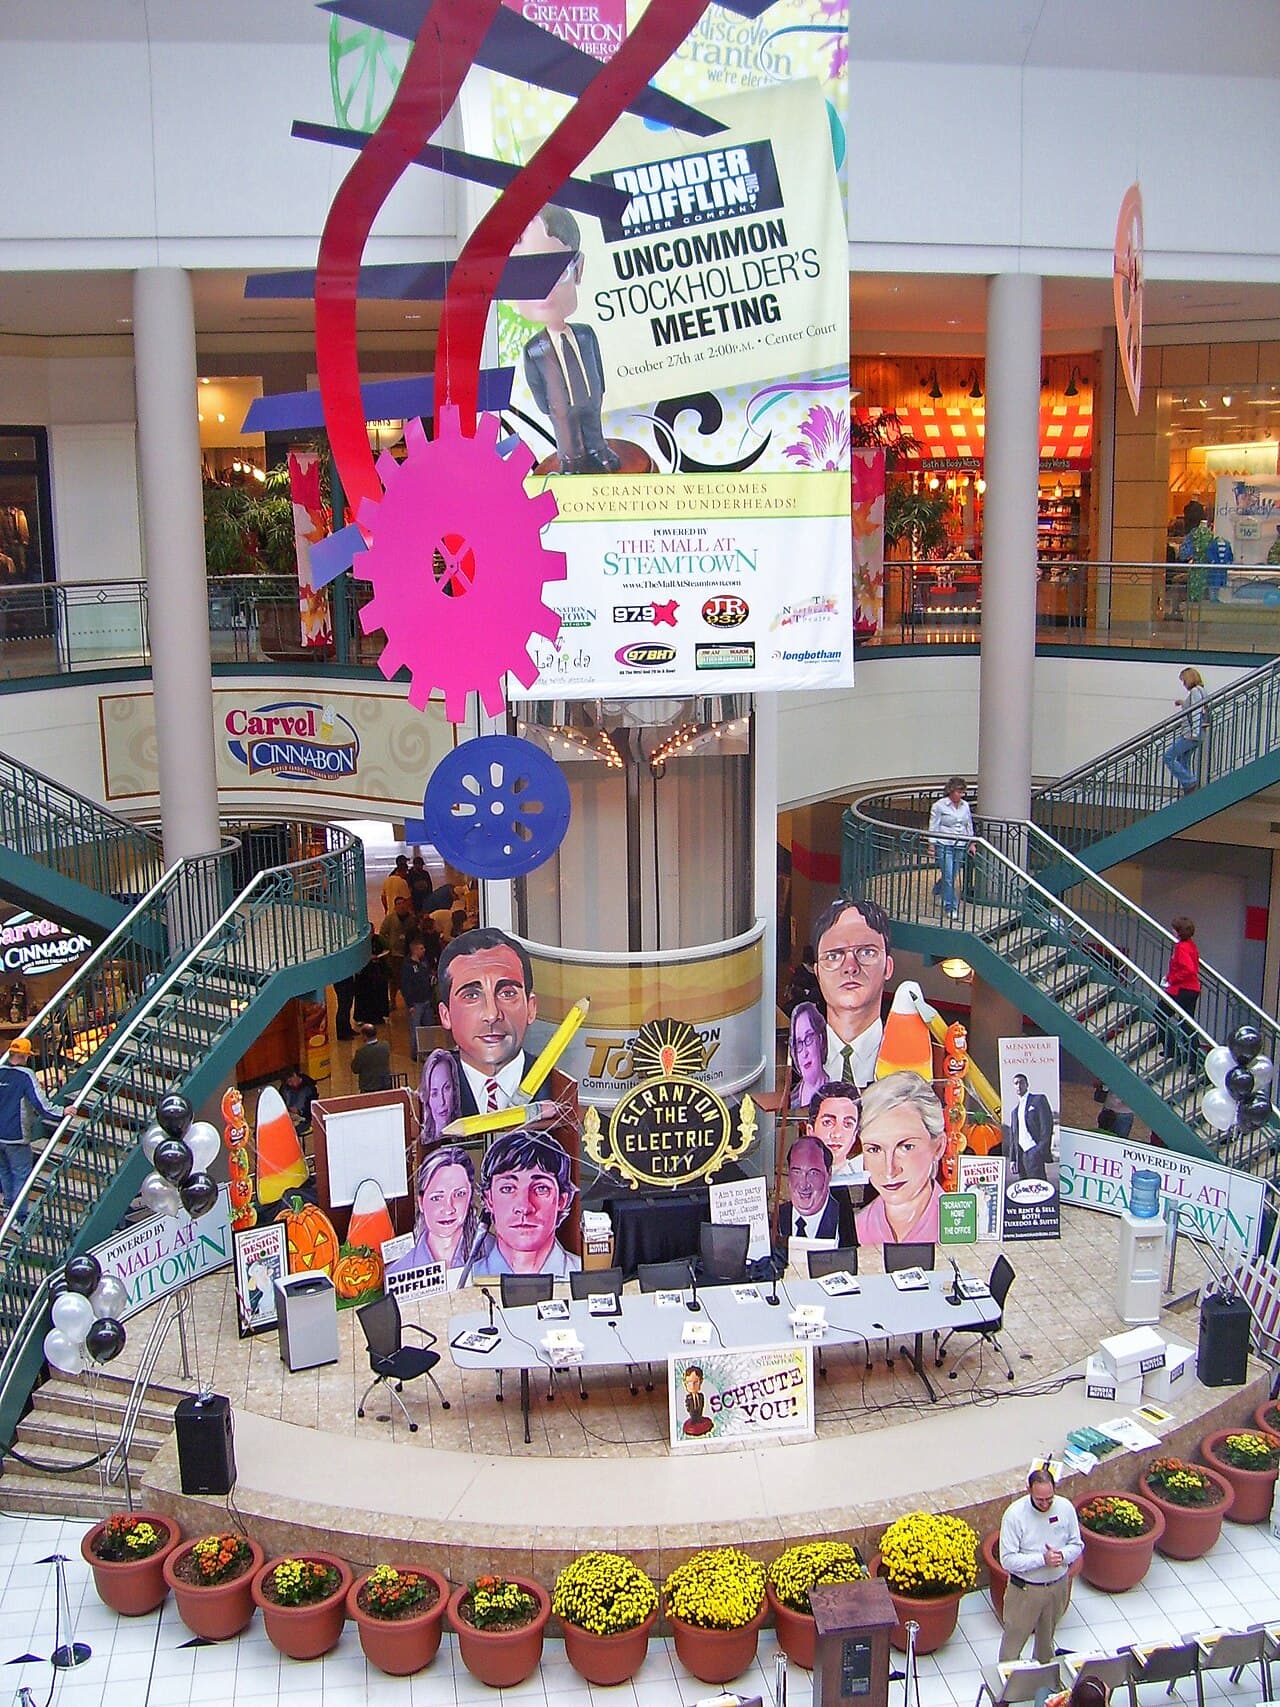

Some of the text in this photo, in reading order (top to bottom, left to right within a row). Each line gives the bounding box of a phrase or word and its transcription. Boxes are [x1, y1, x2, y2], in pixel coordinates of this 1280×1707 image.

[522, 2, 600, 22] GREATER
[538, 22, 623, 42] RANTON
[573, 42, 609, 56] MBER
[612, 147, 750, 197] DUNDER
[623, 203, 757, 236] PAPER COMPANY
[612, 218, 789, 281] UNCOMMON
[594, 248, 821, 323] STOCKHOLDER'S
[650, 292, 782, 348] MEETING
[616, 356, 664, 379] October
[667, 348, 692, 369] 27th
[694, 352, 704, 362] at
[764, 331, 804, 347] Center
[805, 322, 838, 338] Court
[922, 459, 939, 469] Bath
[1039, 460, 1052, 469] ody
[591, 483, 768, 497] SCRANTON WELCOMES
[562, 498, 799, 513] CONVENTION DUNDERHEADS!
[616, 537, 737, 554] THE MALL AT
[653, 528, 709, 536] POWERED BY
[602, 548, 759, 577] STEAMTOWN
[705, 598, 744, 616] JR
[706, 614, 747, 625] 93.7
[782, 649, 842, 663] longbotham
[225, 709, 316, 737] Carvel
[252, 742, 355, 772] CINNABON
[4, 934, 93, 969] CINNABON
[620, 1084, 720, 1127] SCRANTON
[653, 1106, 688, 1124] THE
[625, 1129, 715, 1152] ELECTRIC
[651, 1154, 694, 1173] CITY
[963, 1165, 999, 1177] DESIGN
[1122, 1149, 1195, 1176] POWERED BY
[1074, 1151, 1124, 1180] THE
[1196, 1184, 1228, 1208] AT
[1059, 1163, 1256, 1248] STEATOWN
[106, 1222, 166, 1263] POWERED BY
[115, 1221, 198, 1279] MALL AT
[243, 1234, 280, 1256] DESIGN
[126, 1224, 227, 1307] MTOWN
[388, 1264, 442, 1286] DUNDER
[709, 1367, 804, 1414] SCHRUTE
[740, 1396, 798, 1424] YOU!
